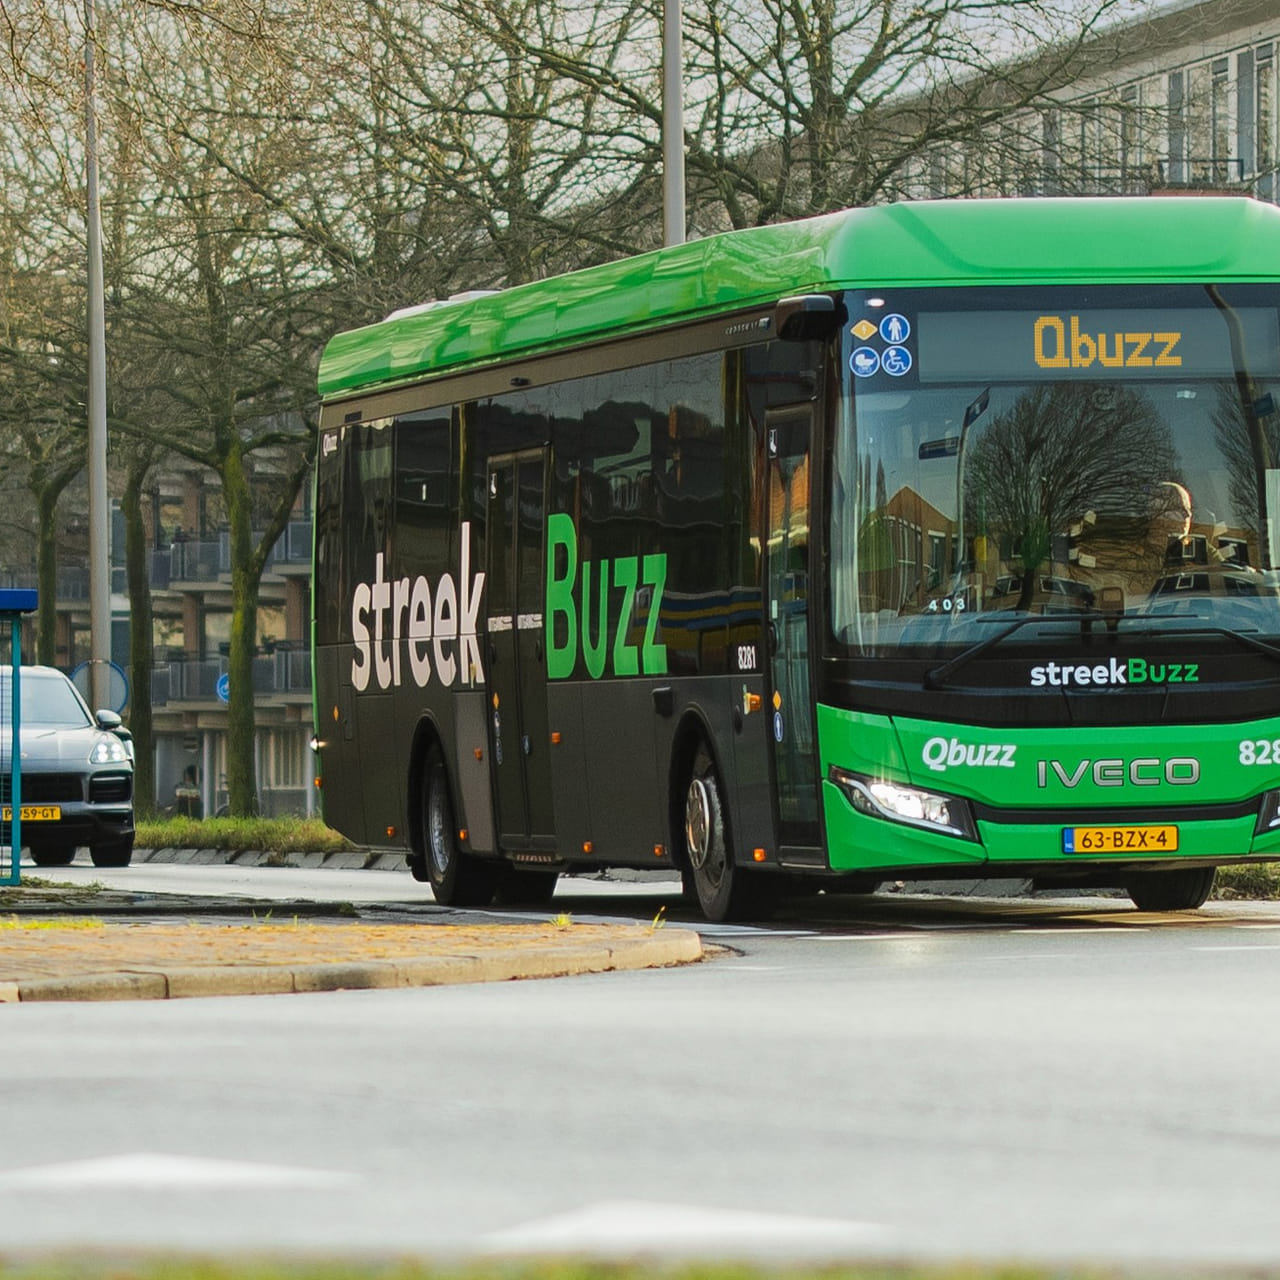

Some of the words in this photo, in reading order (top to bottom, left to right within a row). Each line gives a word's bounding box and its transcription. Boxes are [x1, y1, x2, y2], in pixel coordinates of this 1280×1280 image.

[1034, 316, 1182, 368] Qbuzz
[351, 521, 486, 691] streek
[546, 512, 668, 679] Buzz
[738, 646, 756, 669] 8281
[1030, 657, 1199, 686] streekBuzz
[922, 737, 1017, 771] Qbuzz
[1037, 757, 1201, 788] IVECO
[1081, 830, 1168, 849] 63-BZX-4
